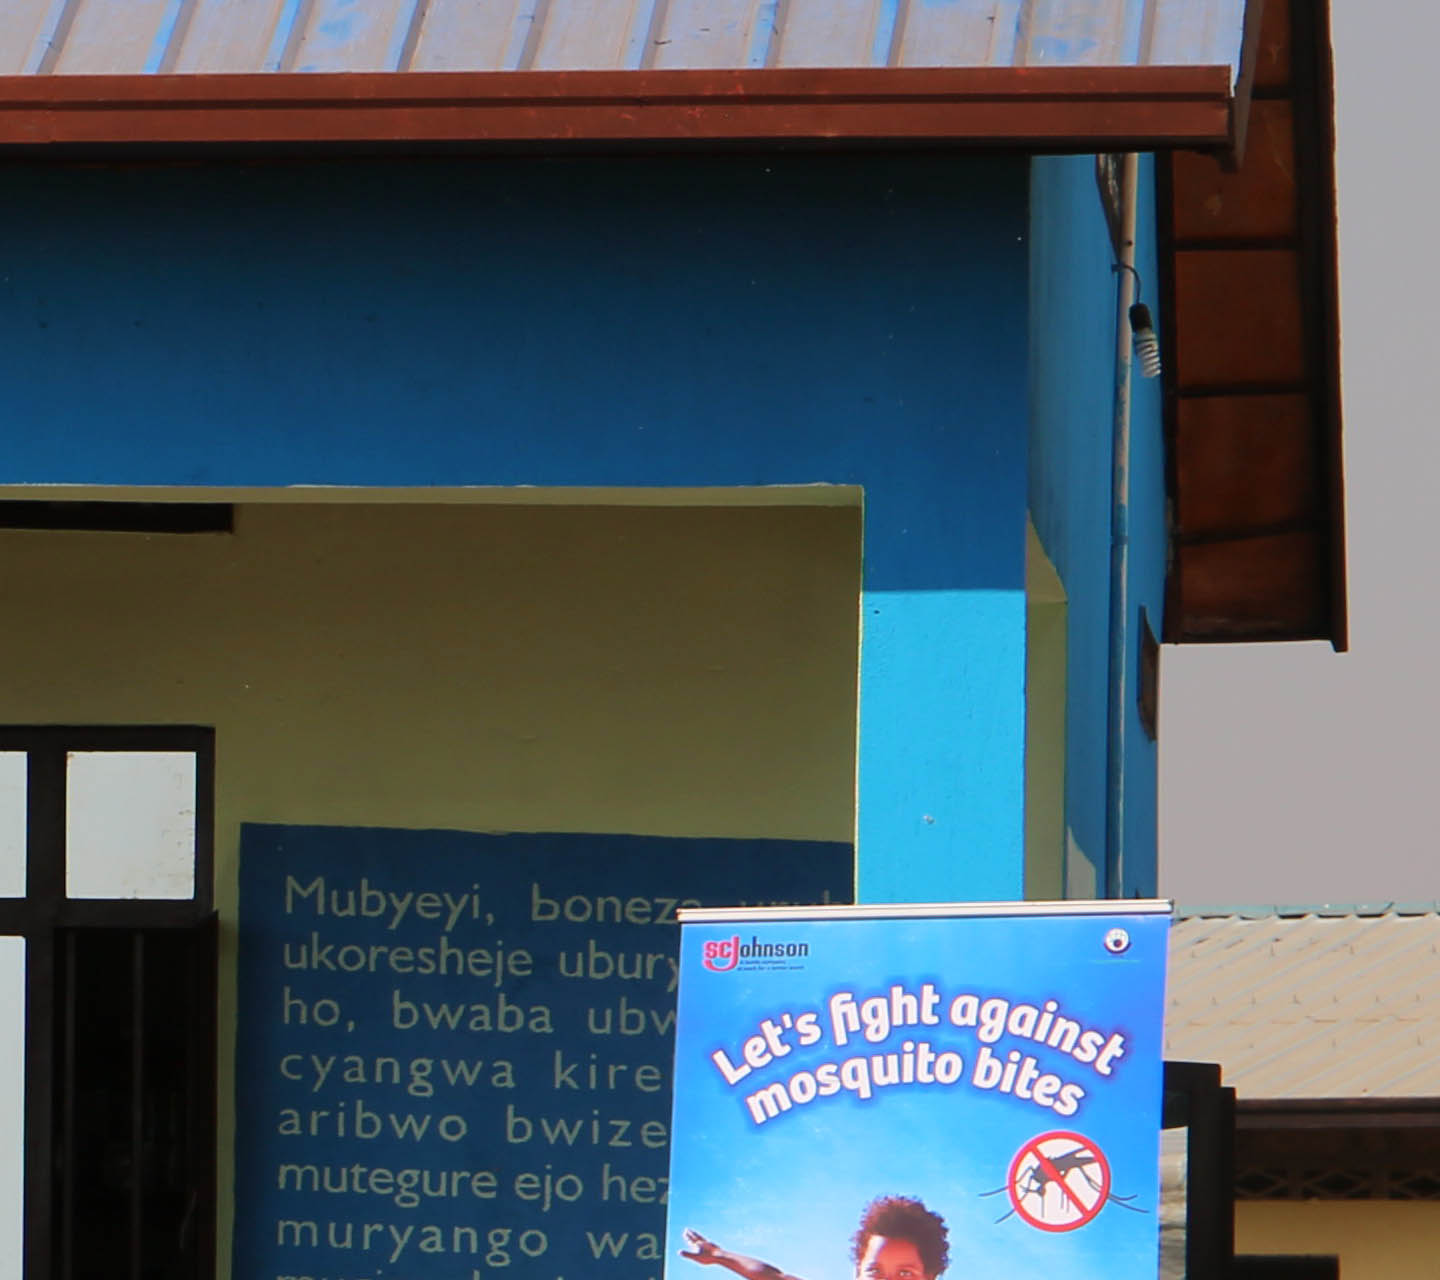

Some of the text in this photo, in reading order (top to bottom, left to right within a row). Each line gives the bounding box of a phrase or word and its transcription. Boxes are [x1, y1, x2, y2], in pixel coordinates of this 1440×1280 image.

[286, 876, 494, 932] Mubyeyi,
[285, 934, 532, 988] ukoresheje
[284, 987, 554, 1033] ho, bwaba
[713, 985, 1125, 1086] Let's fight against
[281, 1055, 516, 1098] cyangwa
[746, 1043, 1085, 1123] mosquito bites
[279, 1100, 467, 1142] aribwo
[279, 1164, 583, 1212] mutegure ejo
[279, 1221, 548, 1267] muryango
